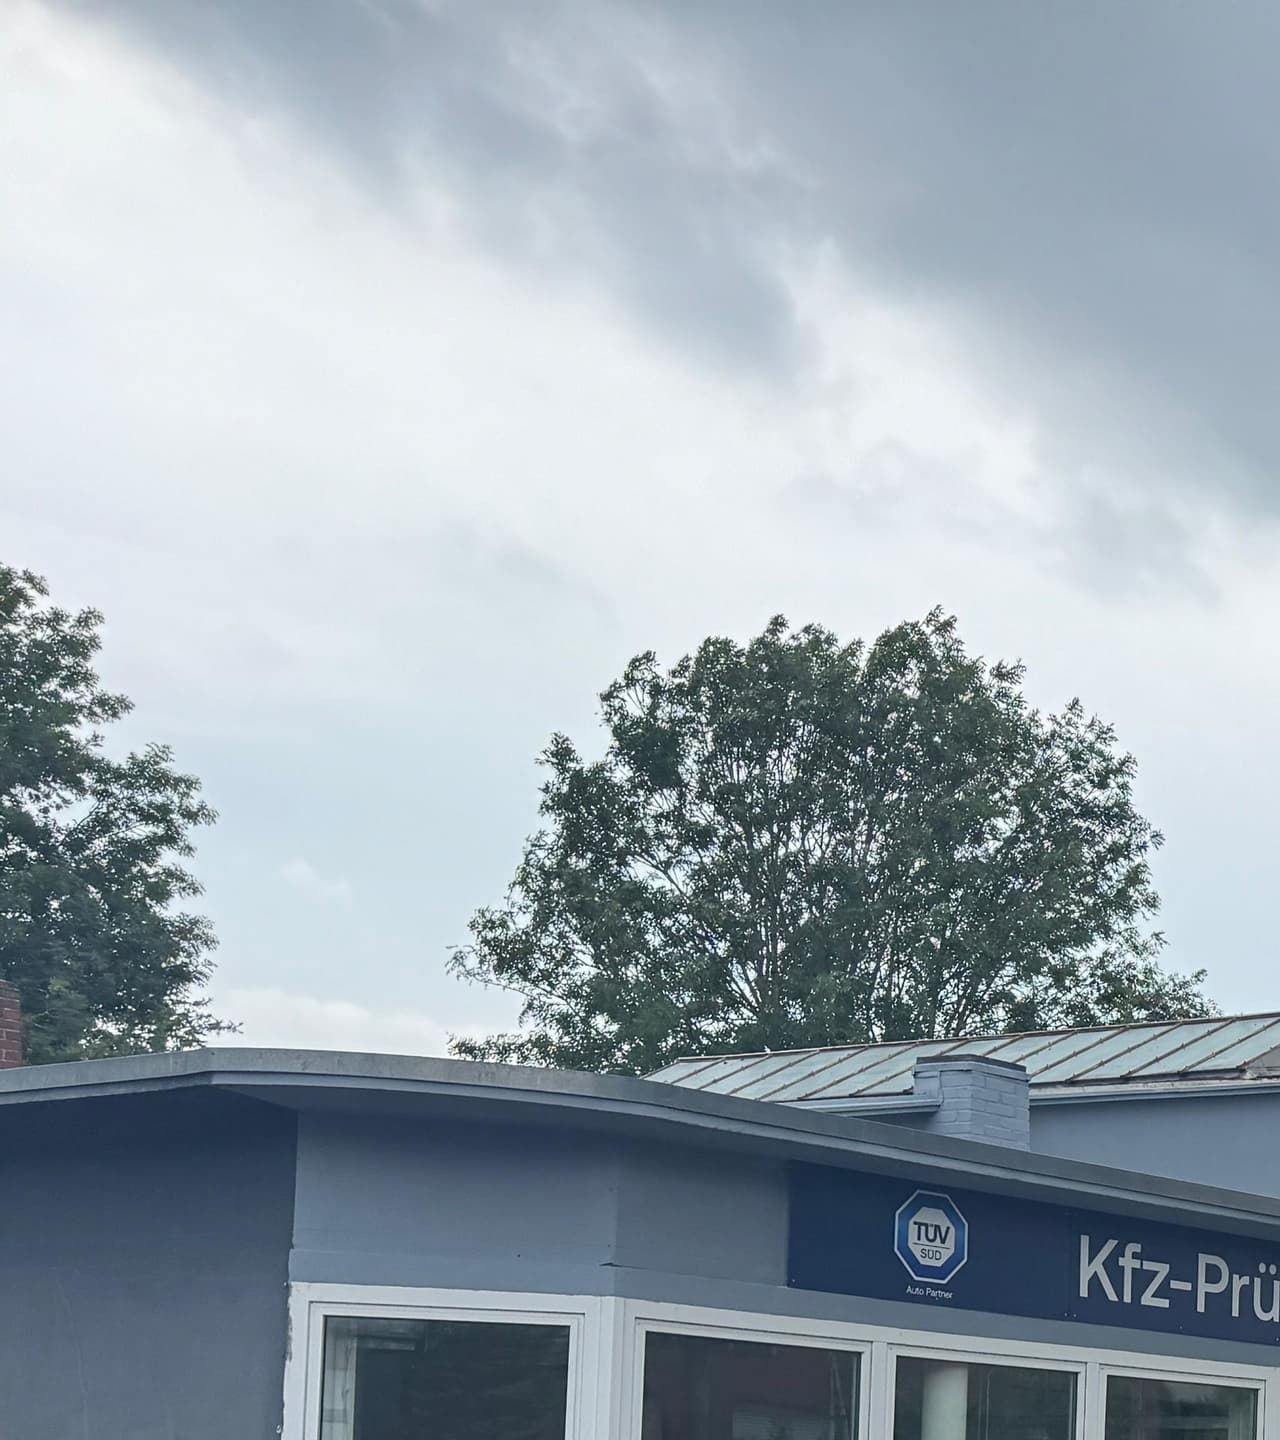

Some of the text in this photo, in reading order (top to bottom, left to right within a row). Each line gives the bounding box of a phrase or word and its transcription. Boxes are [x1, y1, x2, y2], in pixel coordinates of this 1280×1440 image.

[913, 1221, 951, 1245] TÜV
[920, 1248, 942, 1260] SÜD
[906, 1285, 953, 1299] Auto Partner
